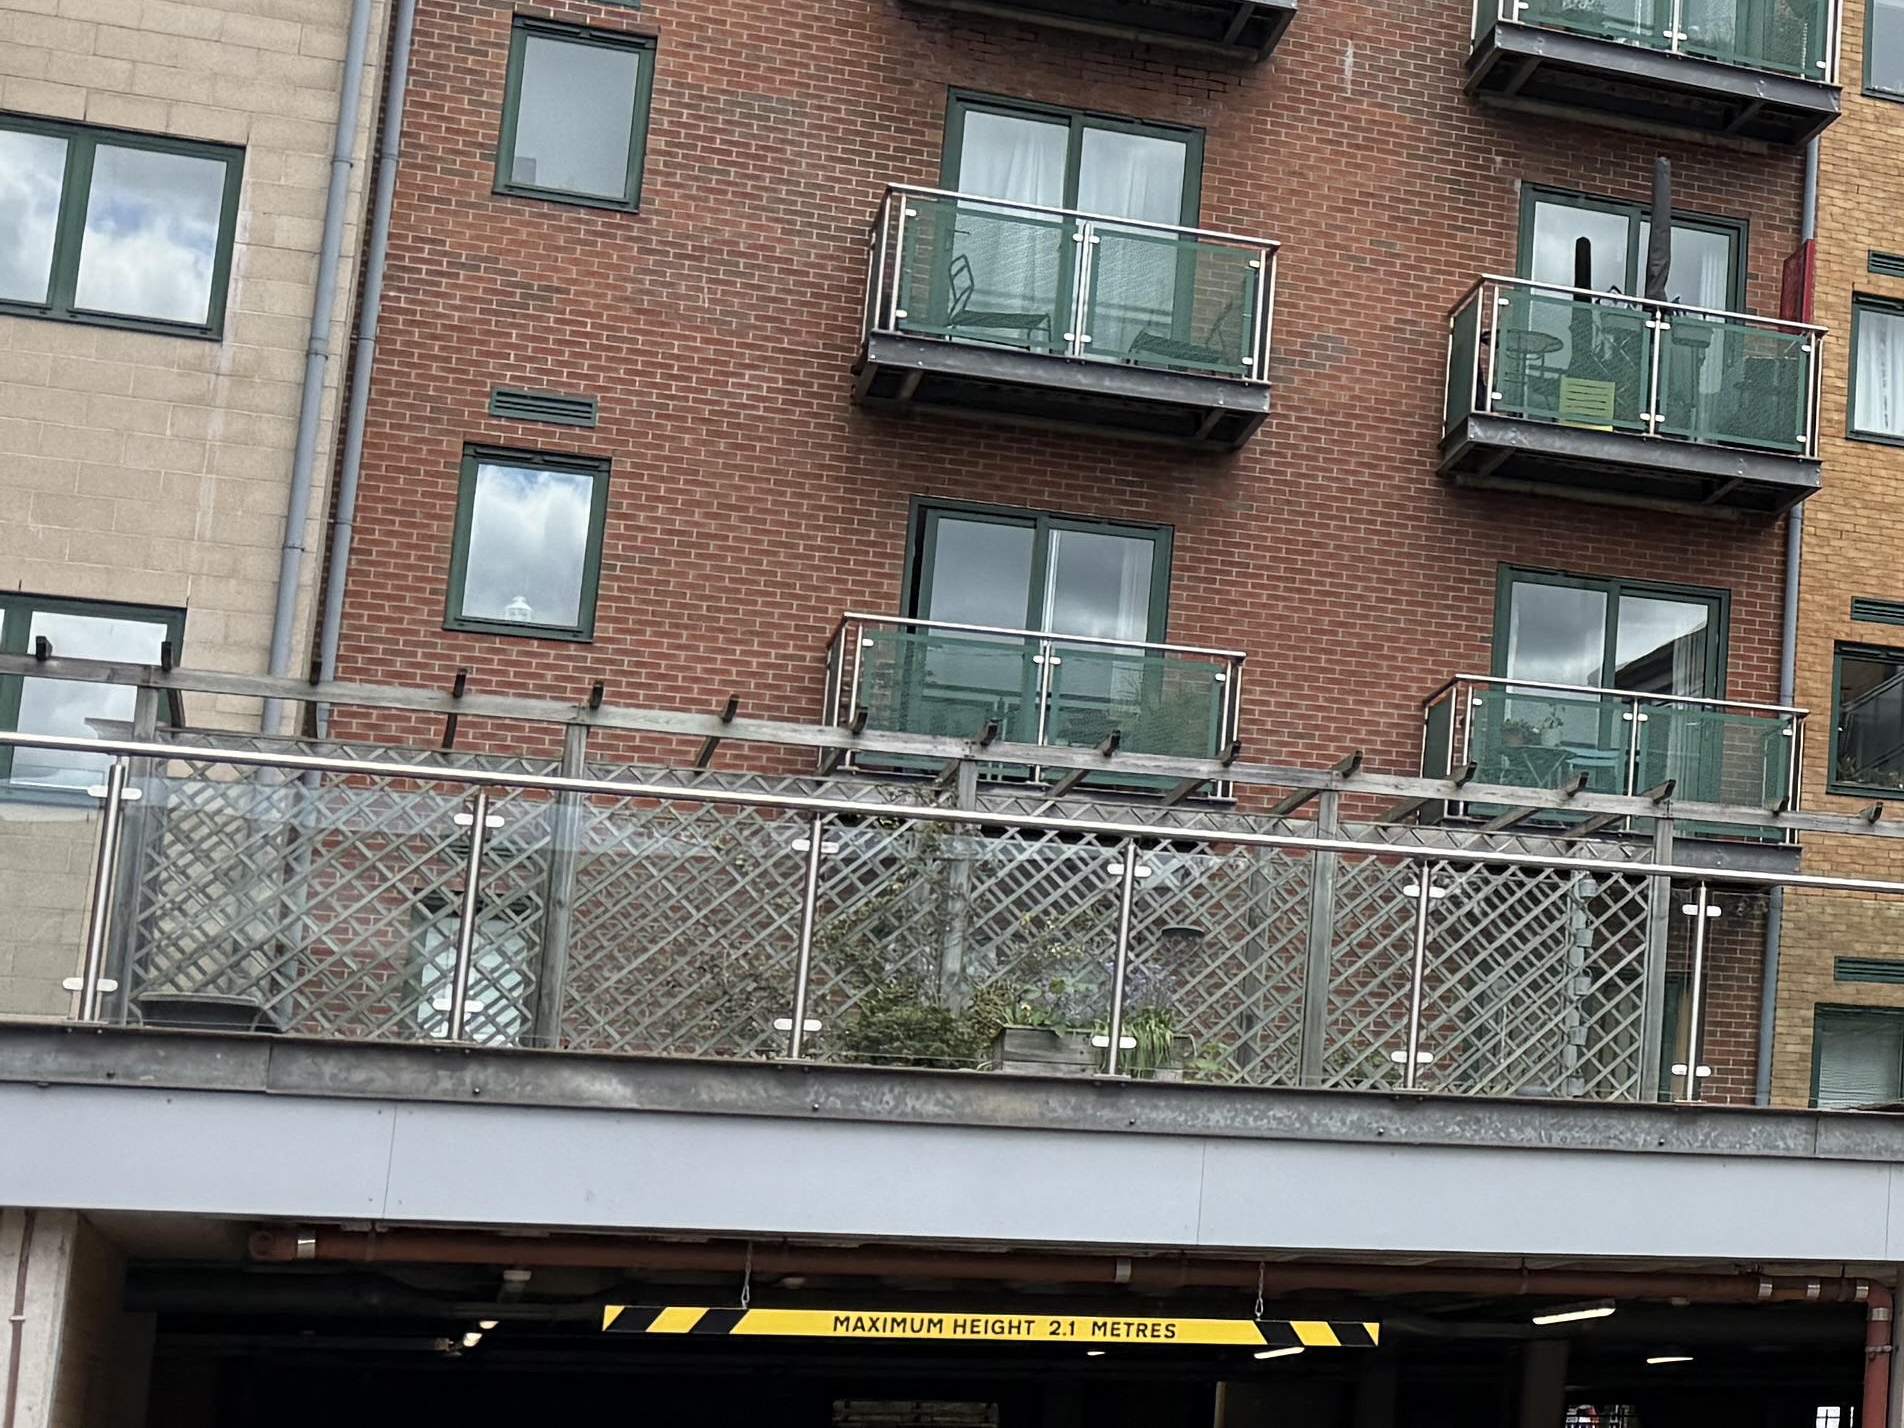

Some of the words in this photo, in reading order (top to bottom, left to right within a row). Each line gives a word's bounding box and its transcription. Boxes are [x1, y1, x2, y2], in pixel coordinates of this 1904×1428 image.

[833, 1315, 944, 1334] MAXIMUM
[953, 1318, 1035, 1335] HEIGHT
[1049, 1320, 1076, 1336] 2.1
[1091, 1321, 1177, 1339] METRES
